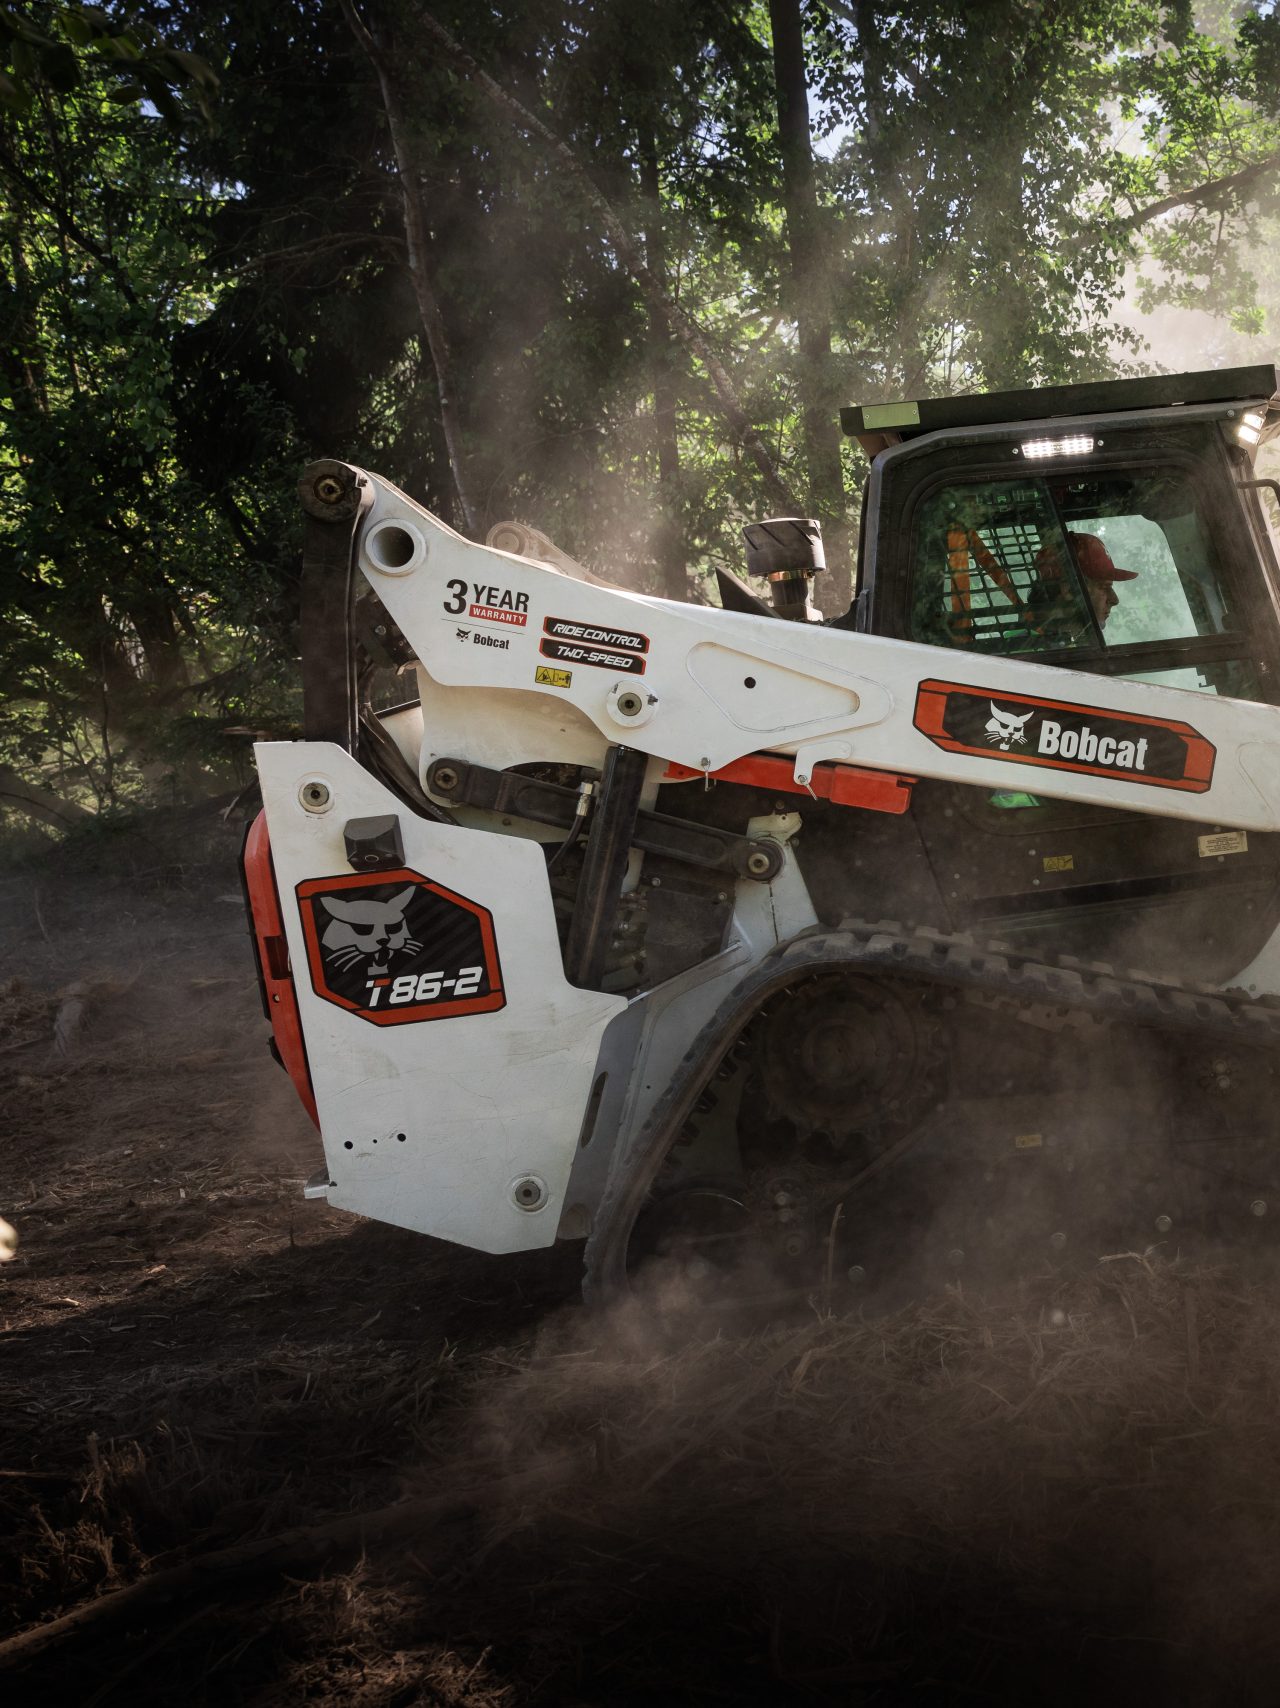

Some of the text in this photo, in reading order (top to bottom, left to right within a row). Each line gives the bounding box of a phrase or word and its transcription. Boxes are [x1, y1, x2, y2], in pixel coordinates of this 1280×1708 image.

[443, 579, 530, 615] 3 YEAR
[472, 607, 524, 624] WARRANTY
[473, 633, 510, 650] Bobcat
[553, 623, 643, 649] RIDE CONTROL
[557, 645, 633, 669] TWO-SPEED
[1037, 719, 1149, 771] Bobcat
